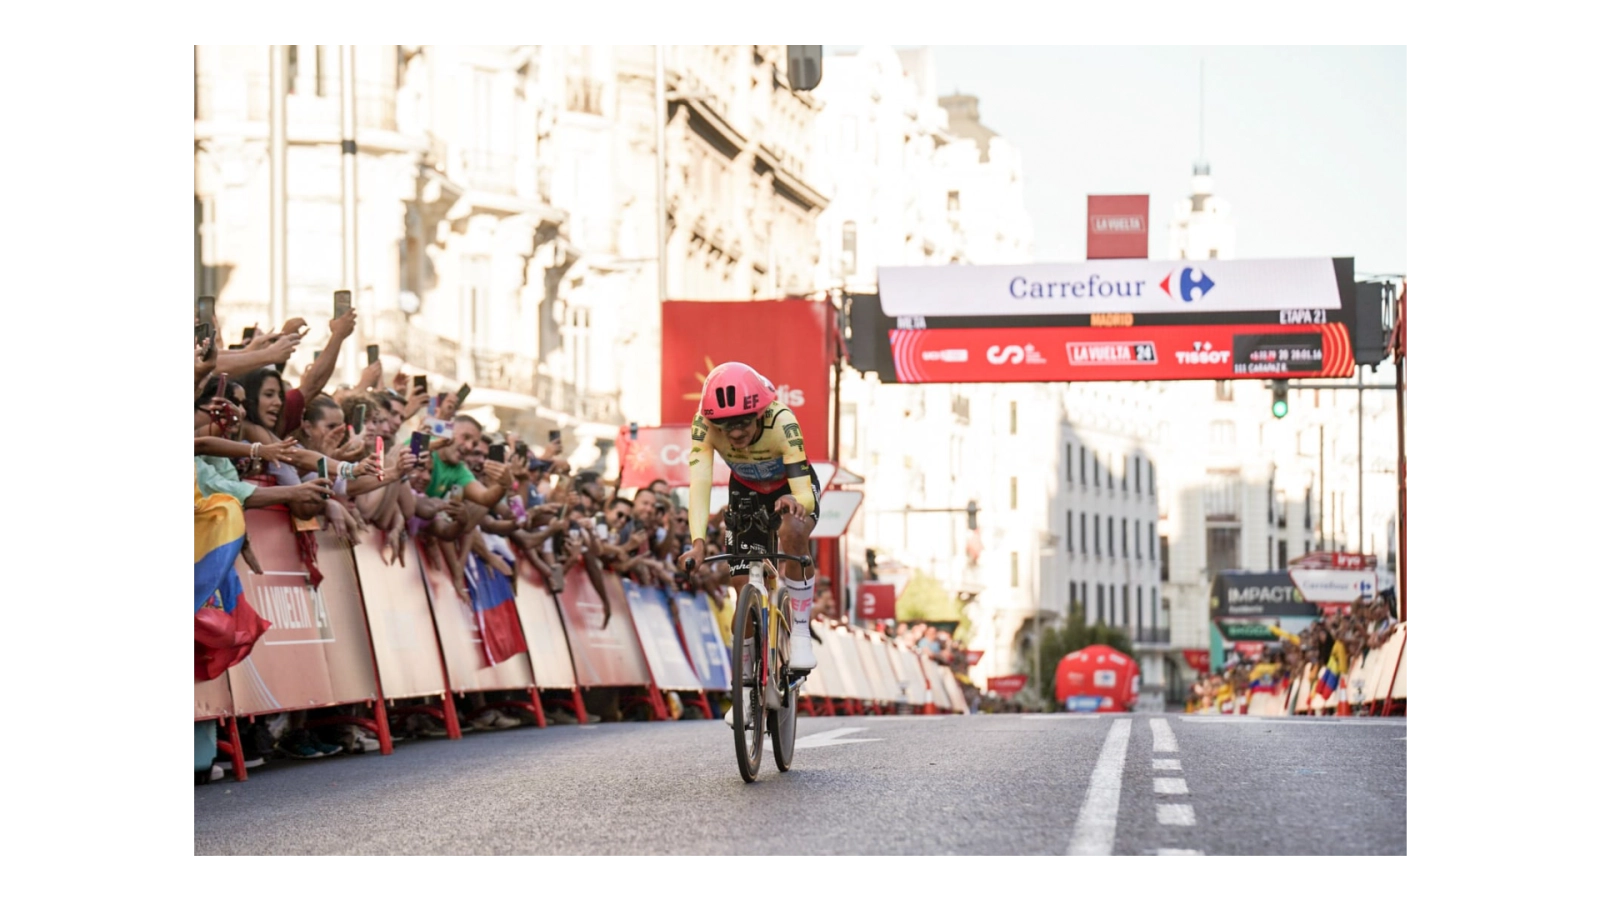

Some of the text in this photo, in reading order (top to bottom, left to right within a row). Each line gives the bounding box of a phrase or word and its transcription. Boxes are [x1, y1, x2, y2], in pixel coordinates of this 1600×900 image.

[1096, 217, 1141, 231] LA VUELTA
[1009, 274, 1146, 299] Carrefour
[896, 315, 927, 329] META
[1090, 312, 1134, 328] MADRID
[1279, 309, 1327, 325] ETAPA 21
[1073, 345, 1152, 361] LA VUELTA 24
[1175, 351, 1230, 365] TISSOT
[743, 394, 759, 410] EF
[270, 586, 312, 629] VUELTA
[791, 597, 812, 612] EF
